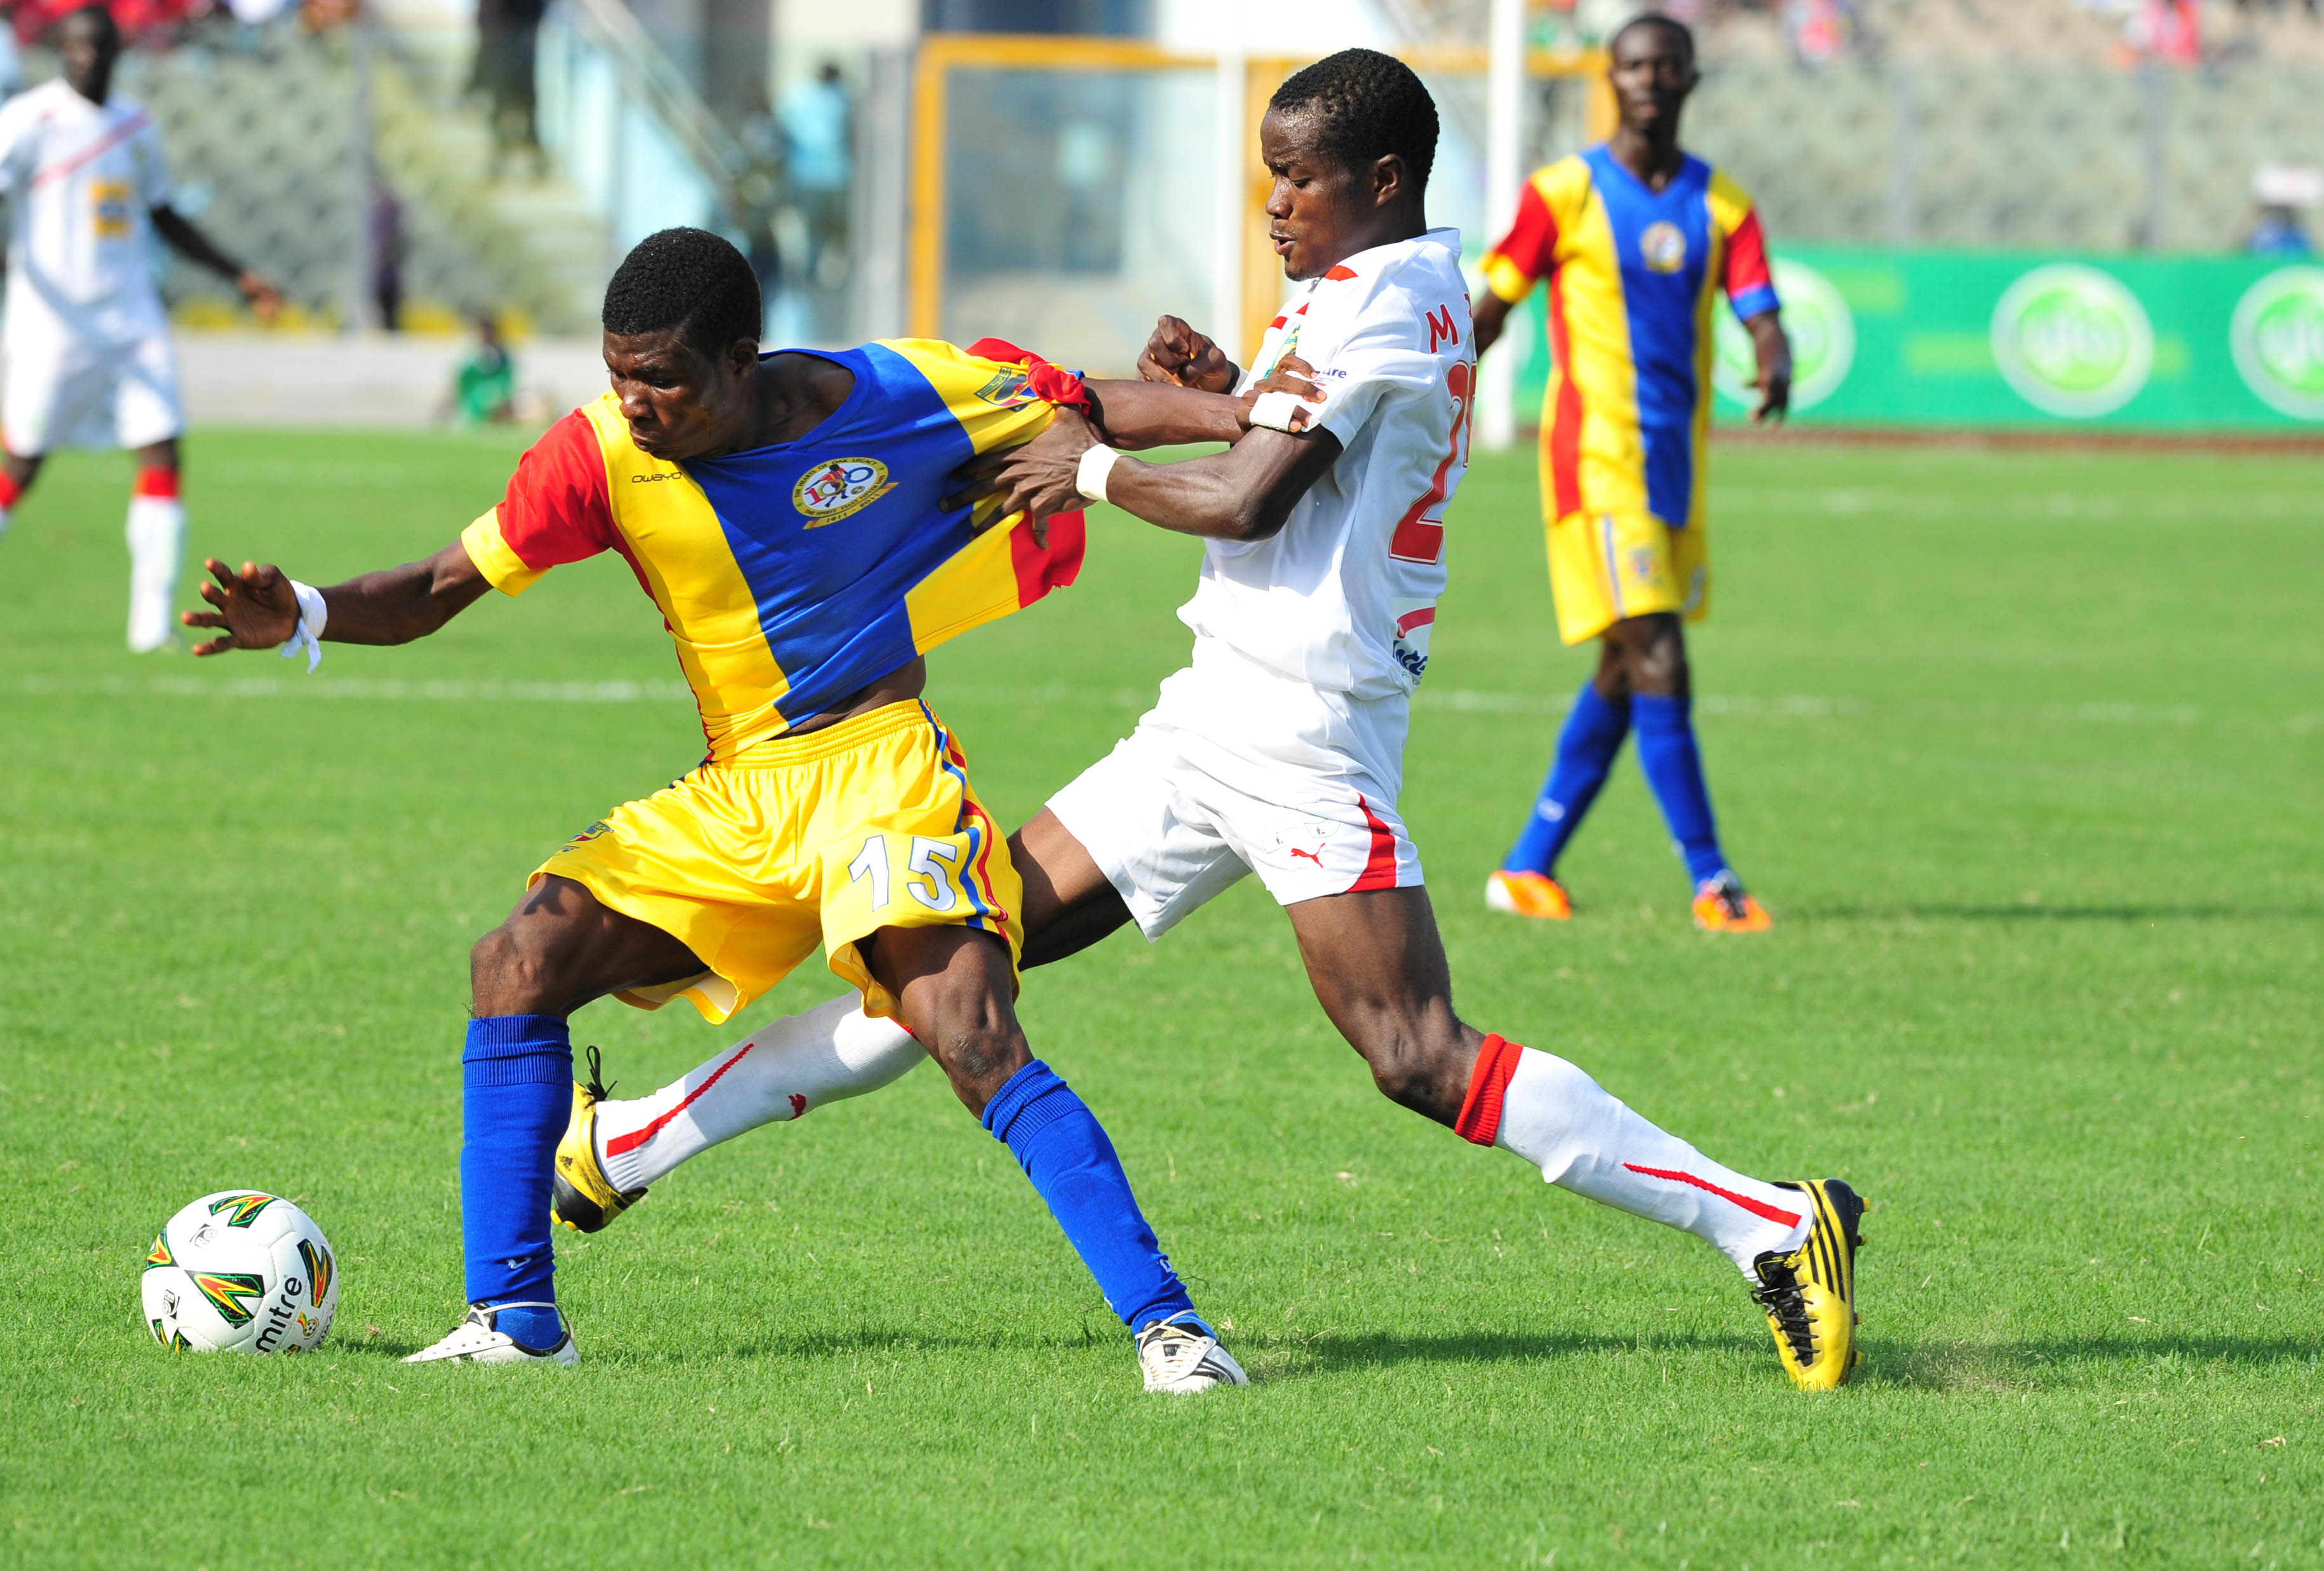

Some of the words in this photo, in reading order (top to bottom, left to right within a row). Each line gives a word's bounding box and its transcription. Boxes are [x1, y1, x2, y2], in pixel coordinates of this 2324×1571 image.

[1425, 295, 1471, 353] M
[1316, 368, 1348, 379] ure
[1389, 359, 1477, 565] 2
[848, 834, 957, 913] 15
[255, 1277, 302, 1353] mitre
